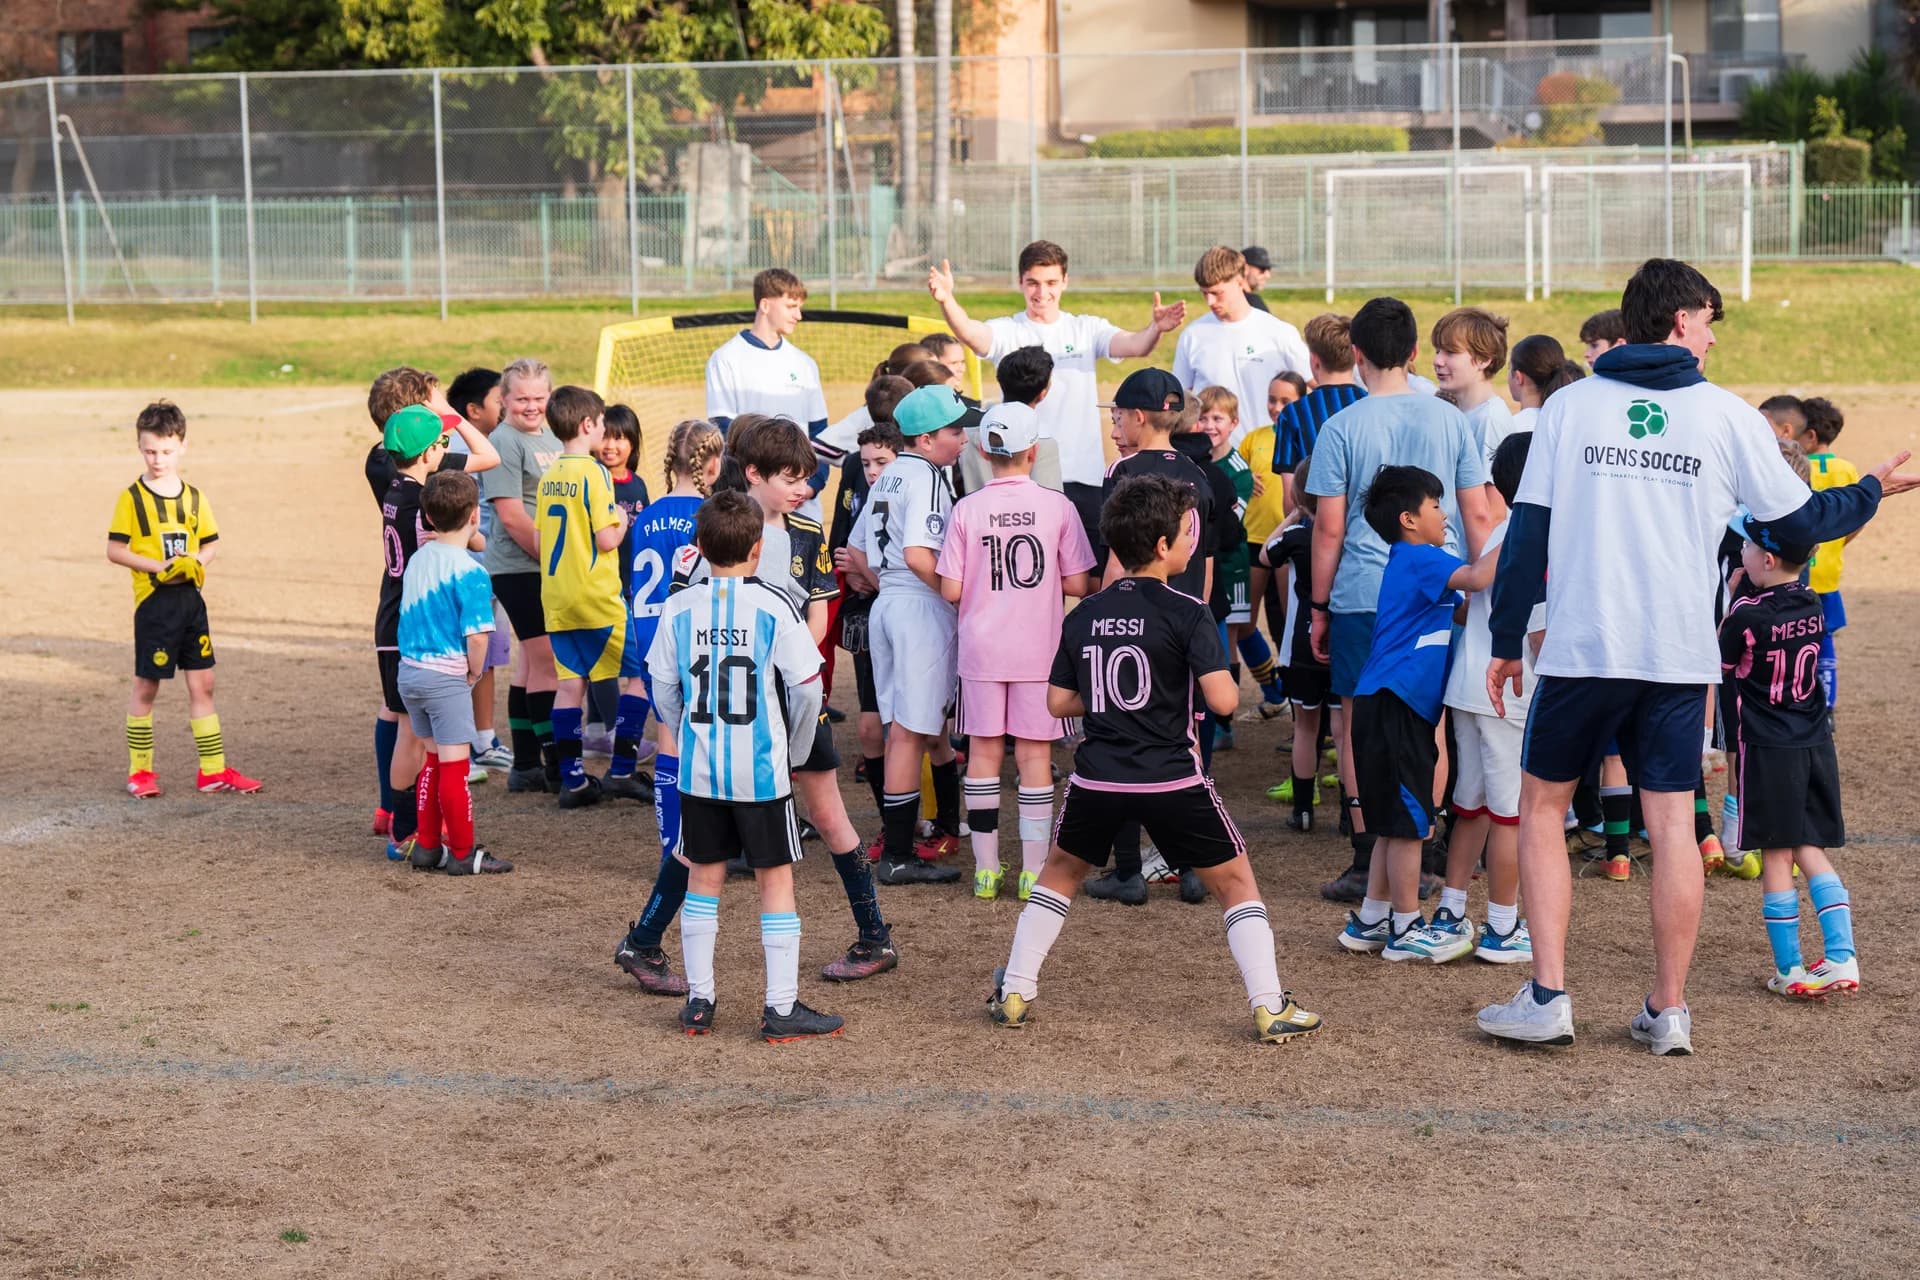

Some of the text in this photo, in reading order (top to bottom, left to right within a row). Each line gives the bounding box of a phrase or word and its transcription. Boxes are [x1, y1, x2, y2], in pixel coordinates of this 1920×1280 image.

[1584, 446, 1702, 477] OVENS SOCCER
[547, 504, 568, 576] 7
[644, 516, 693, 536] PALMER
[989, 511, 1036, 528] MESSI
[383, 525, 404, 578] 0
[982, 533, 1045, 591] 10
[696, 628, 748, 646] MESSI
[1091, 618, 1145, 636] MESSI
[1771, 612, 1825, 642] MESSI
[688, 654, 758, 725] 10
[1082, 644, 1152, 713] 10
[1766, 642, 1821, 705] 10
